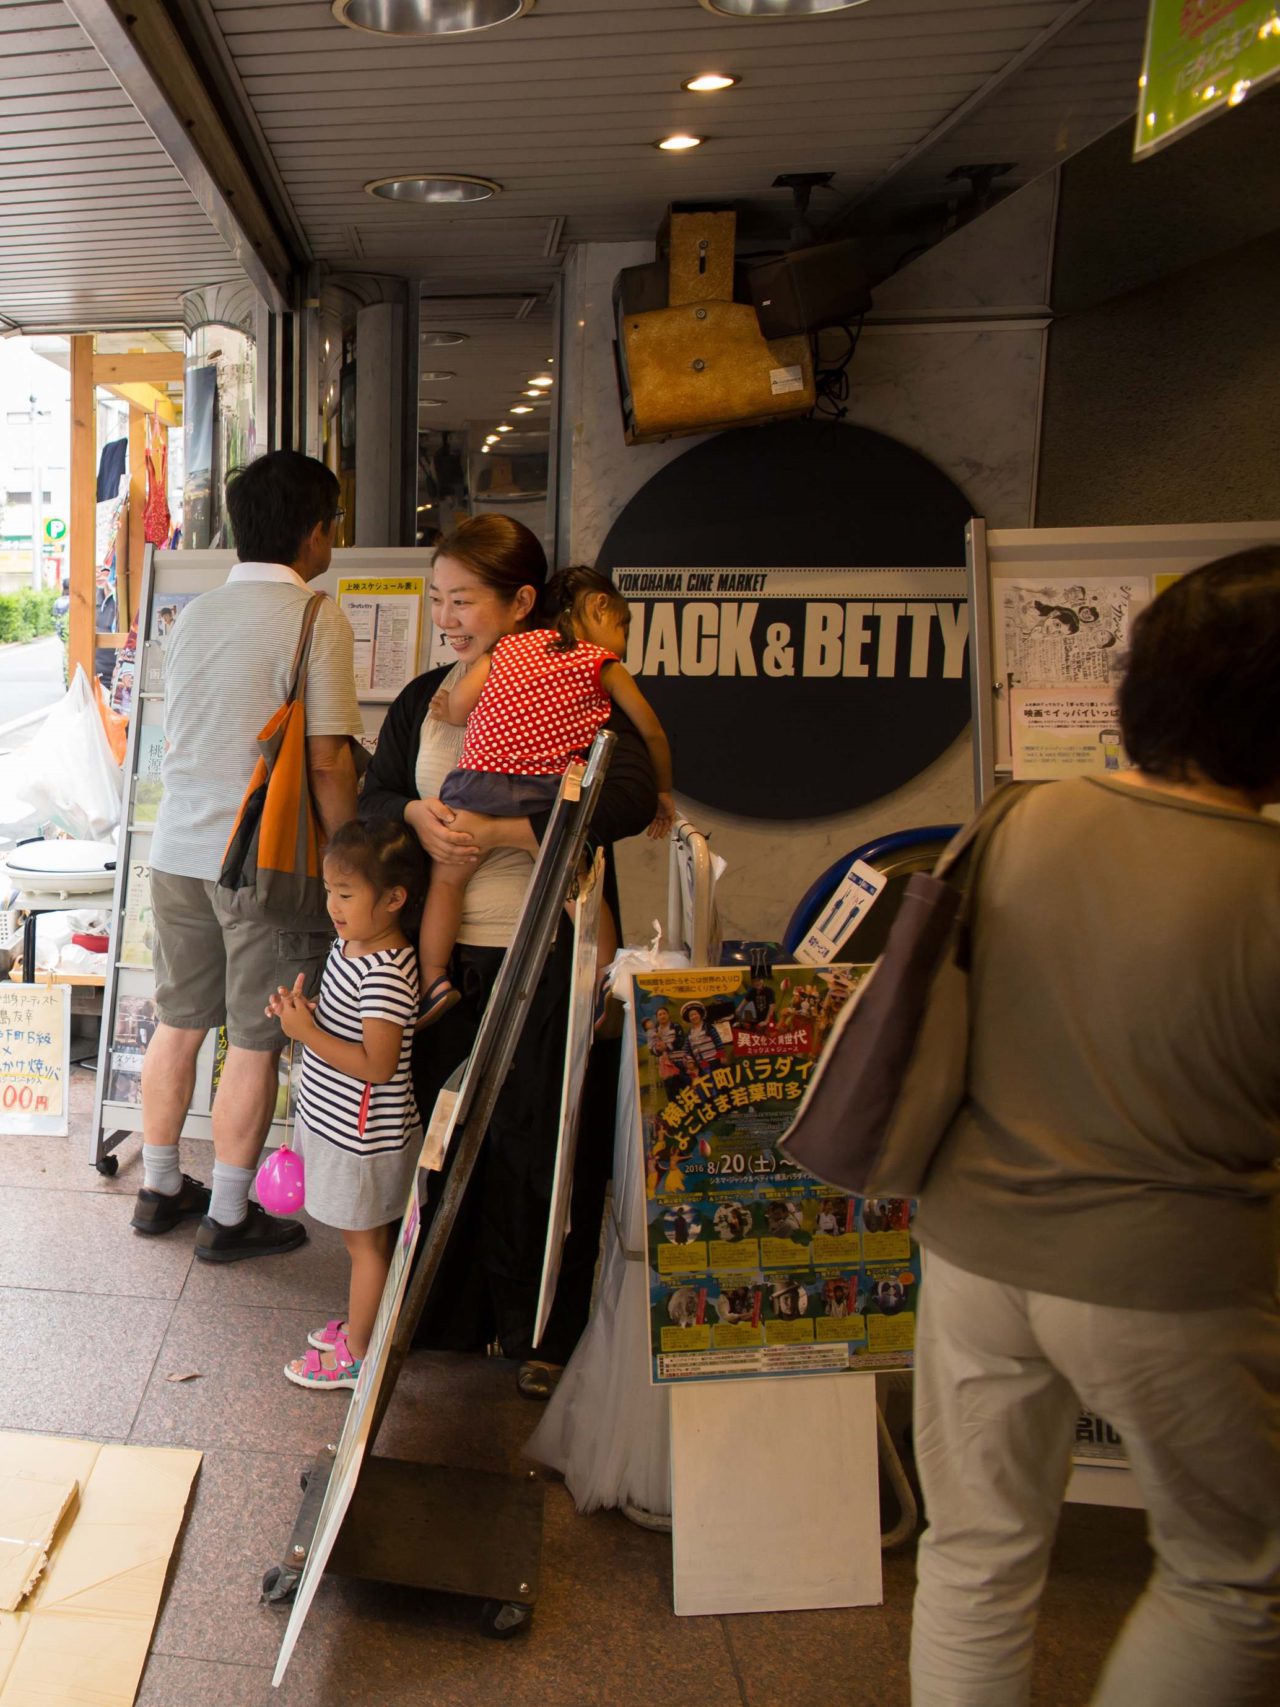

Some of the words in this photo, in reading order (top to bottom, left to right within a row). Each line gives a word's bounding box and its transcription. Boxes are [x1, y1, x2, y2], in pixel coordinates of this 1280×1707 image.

[51, 521, 65, 538] P
[618, 573, 683, 592] YOKOHAMA
[686, 573, 714, 592] CINE
[717, 573, 768, 592] MARKET
[621, 602, 759, 677] JACK
[763, 622, 794, 677] &
[802, 602, 969, 679] BETTY
[674, 1082, 810, 1150] よこはま若葉町多
